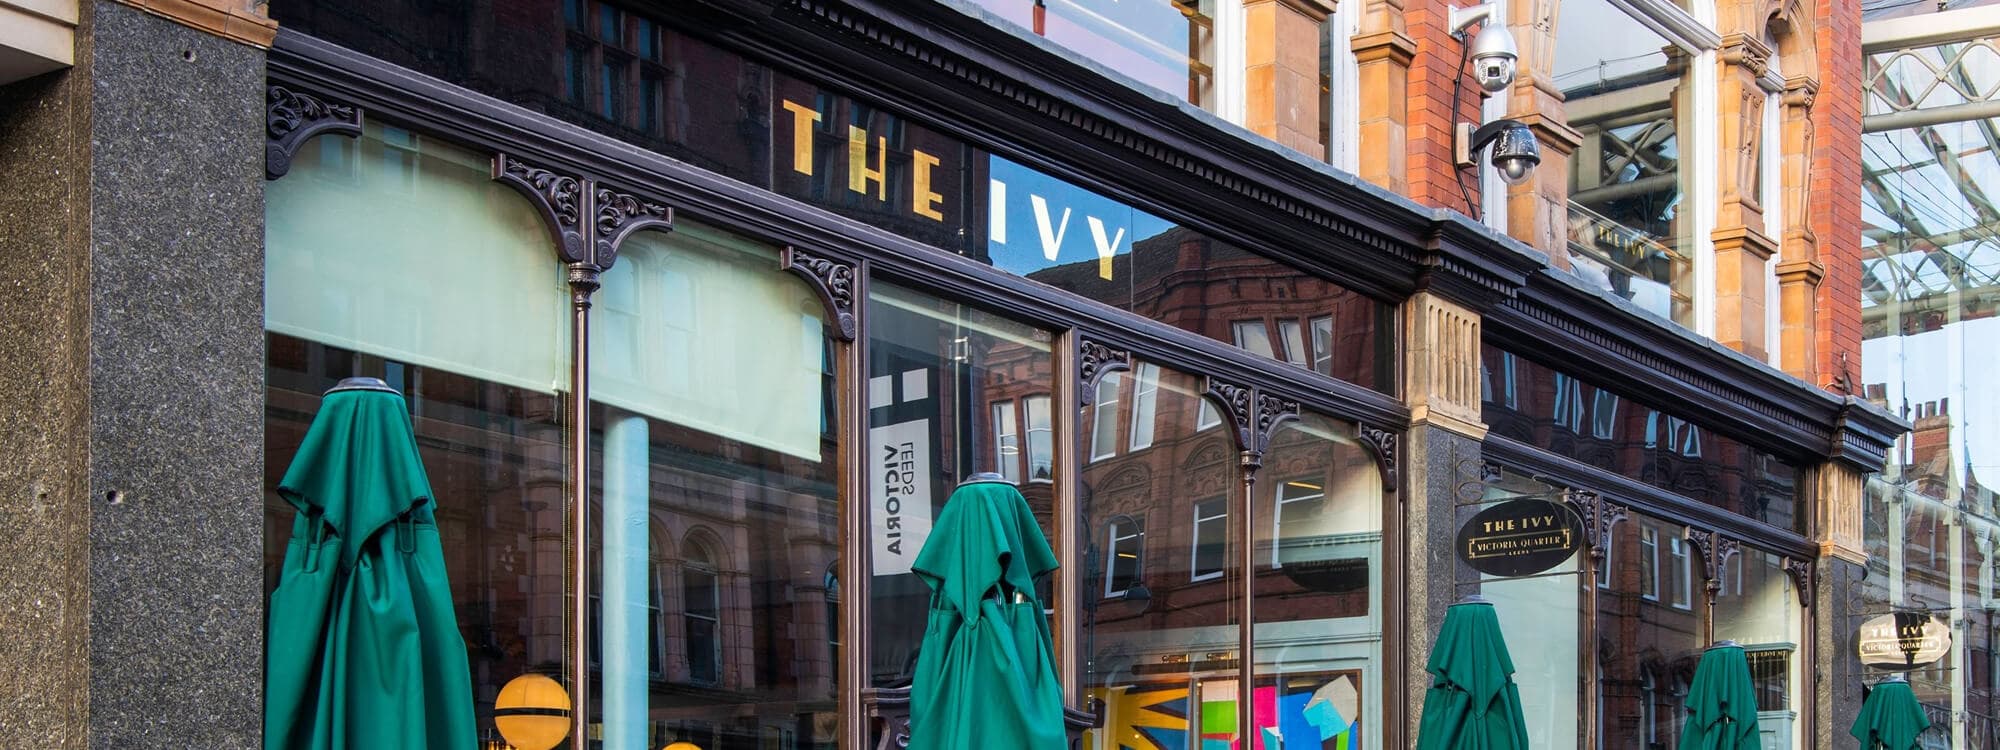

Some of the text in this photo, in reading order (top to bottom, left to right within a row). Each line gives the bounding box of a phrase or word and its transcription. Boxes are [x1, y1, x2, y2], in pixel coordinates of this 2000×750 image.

[783, 99, 1124, 281] THE IVY
[1599, 225, 1645, 259] THE IVY
[1484, 515, 1554, 533] THE IVY
[1477, 536, 1561, 552] VICTORIA QUARTER
[1871, 625, 1929, 637] THE IVY
